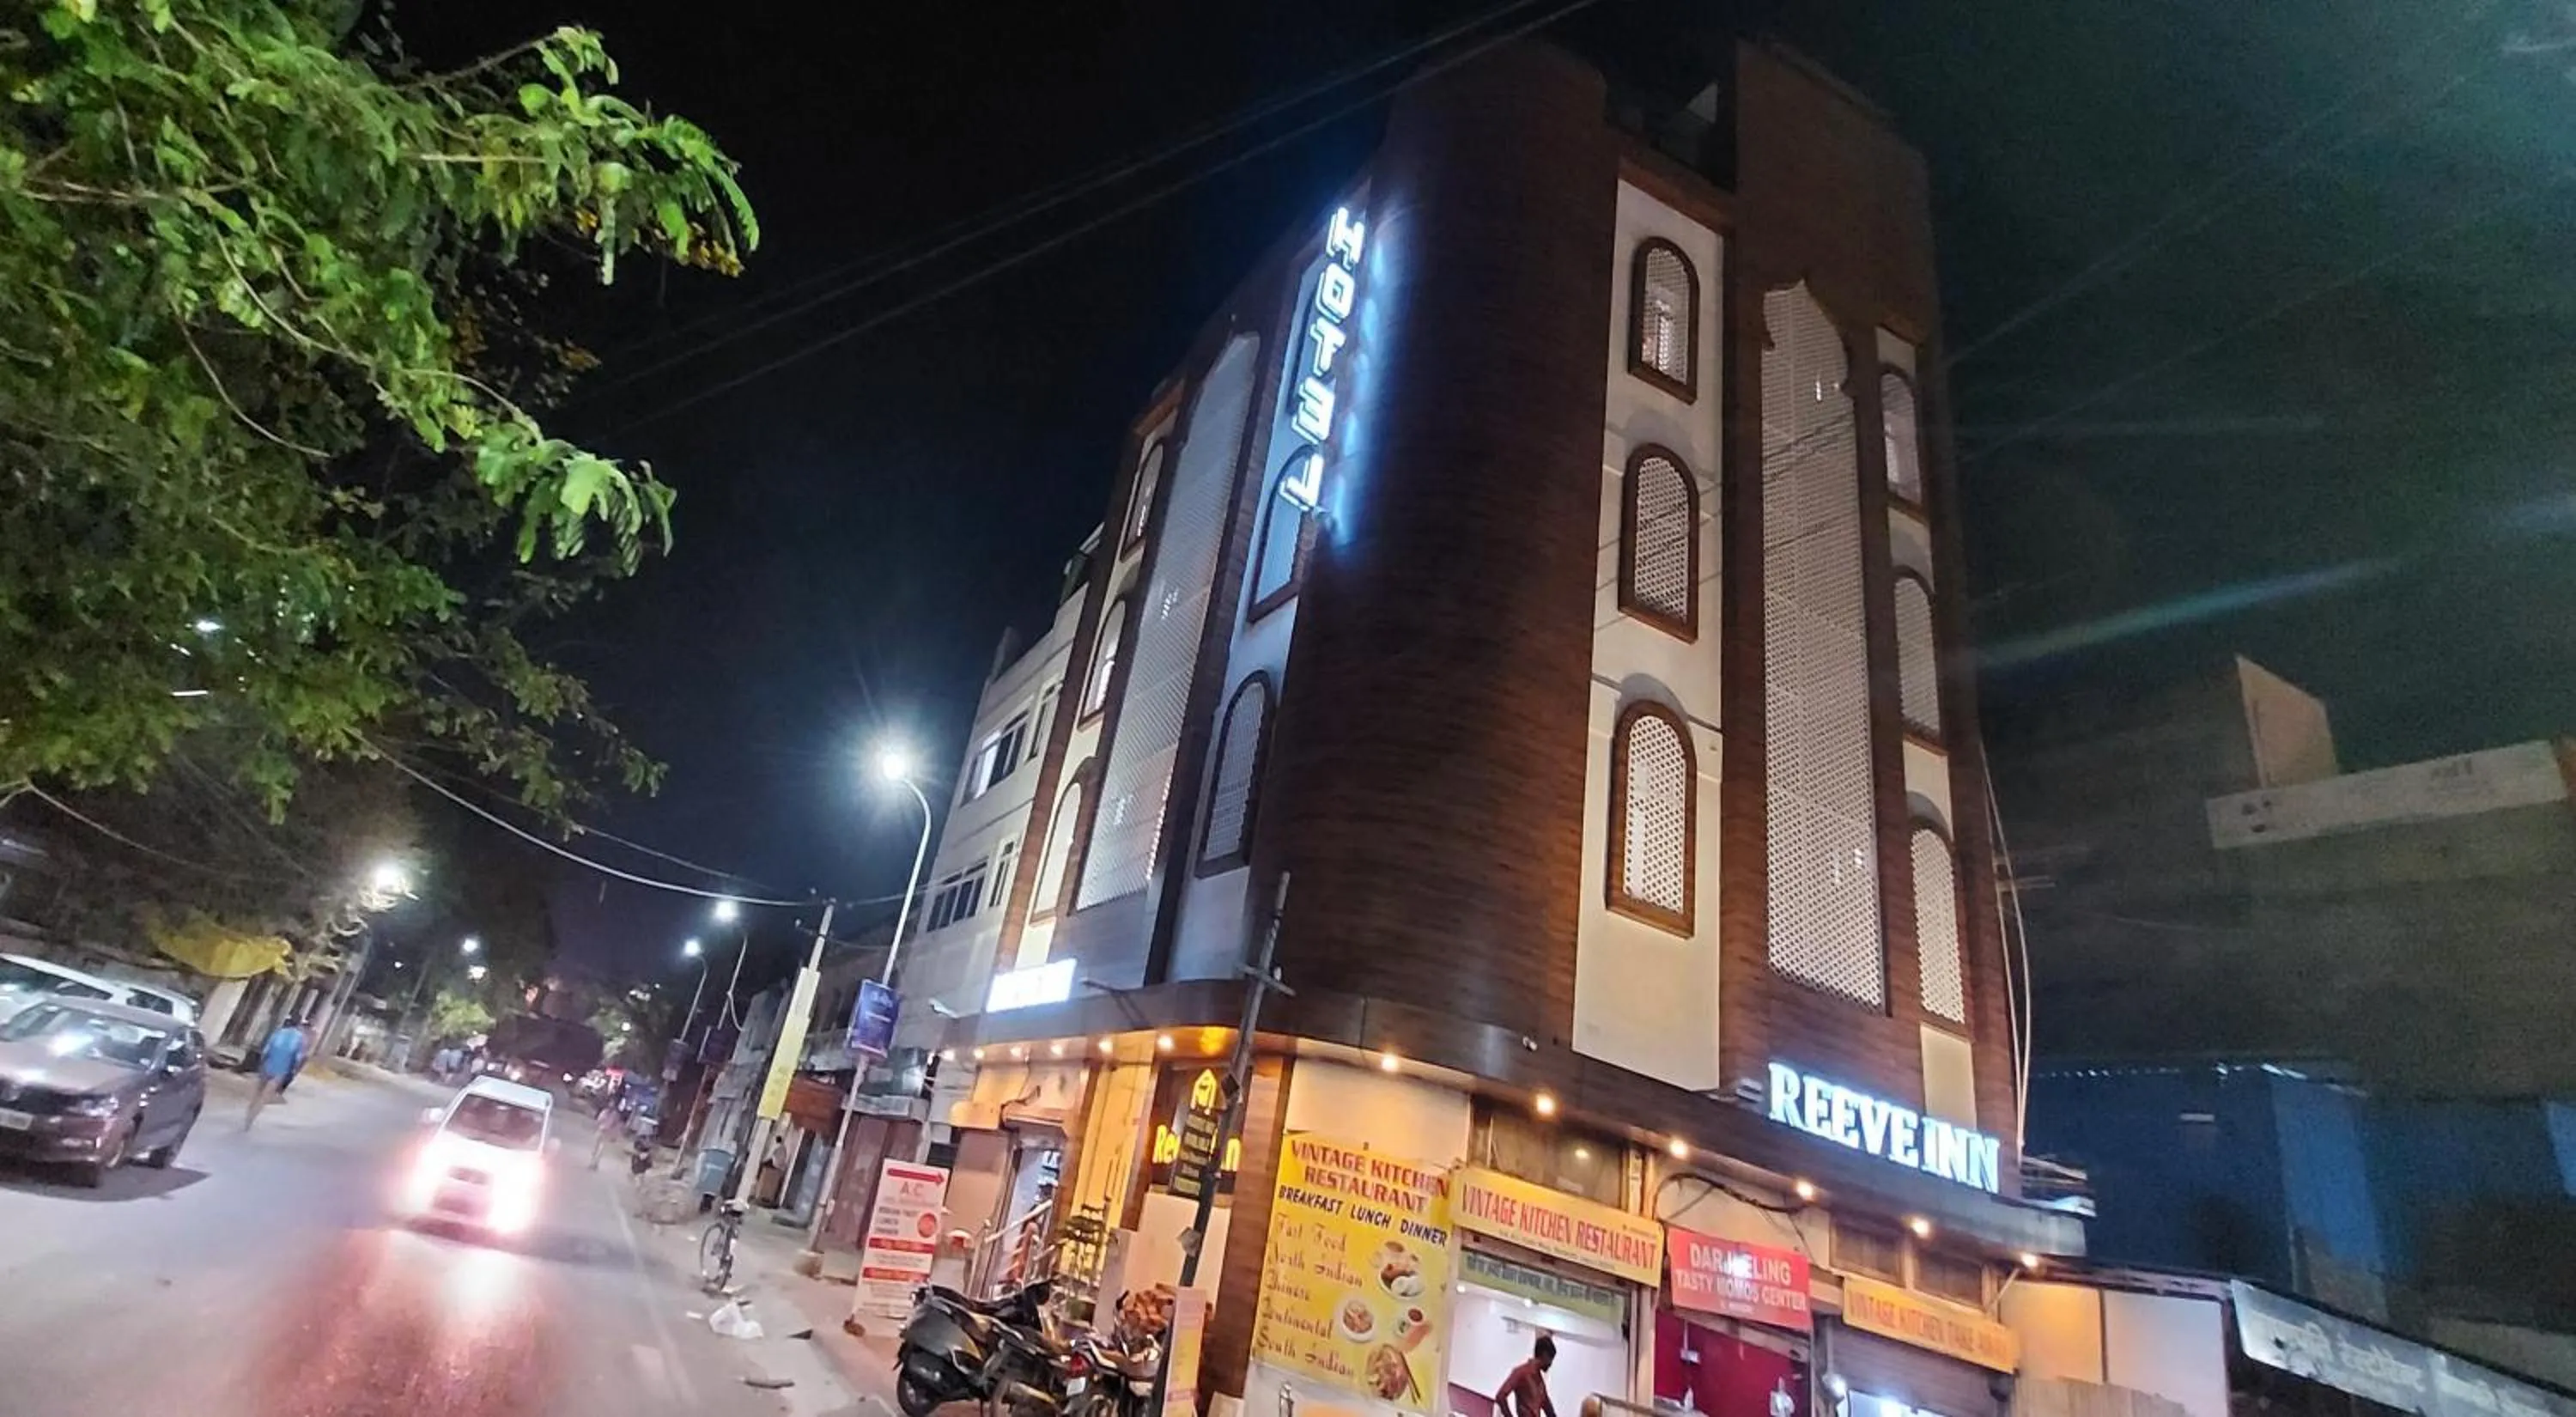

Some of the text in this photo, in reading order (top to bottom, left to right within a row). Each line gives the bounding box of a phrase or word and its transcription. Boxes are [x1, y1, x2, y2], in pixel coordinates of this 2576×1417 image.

[1768, 1061, 2001, 1195] REEVE INN
[1291, 1140, 1450, 1199] VINTAGE KITCHEN
[1304, 1165, 1428, 1213] RESTAURANT
[1279, 1184, 1449, 1247] BREAKFAST LUNCH DINNER
[1461, 1182, 1518, 1227] VINTAGE
[1519, 1201, 1572, 1244] KITCHEN
[1575, 1219, 1657, 1269] RESTAURANT
[1676, 1268, 1716, 1293] TASTY
[1689, 1242, 1792, 1286] DARJELING
